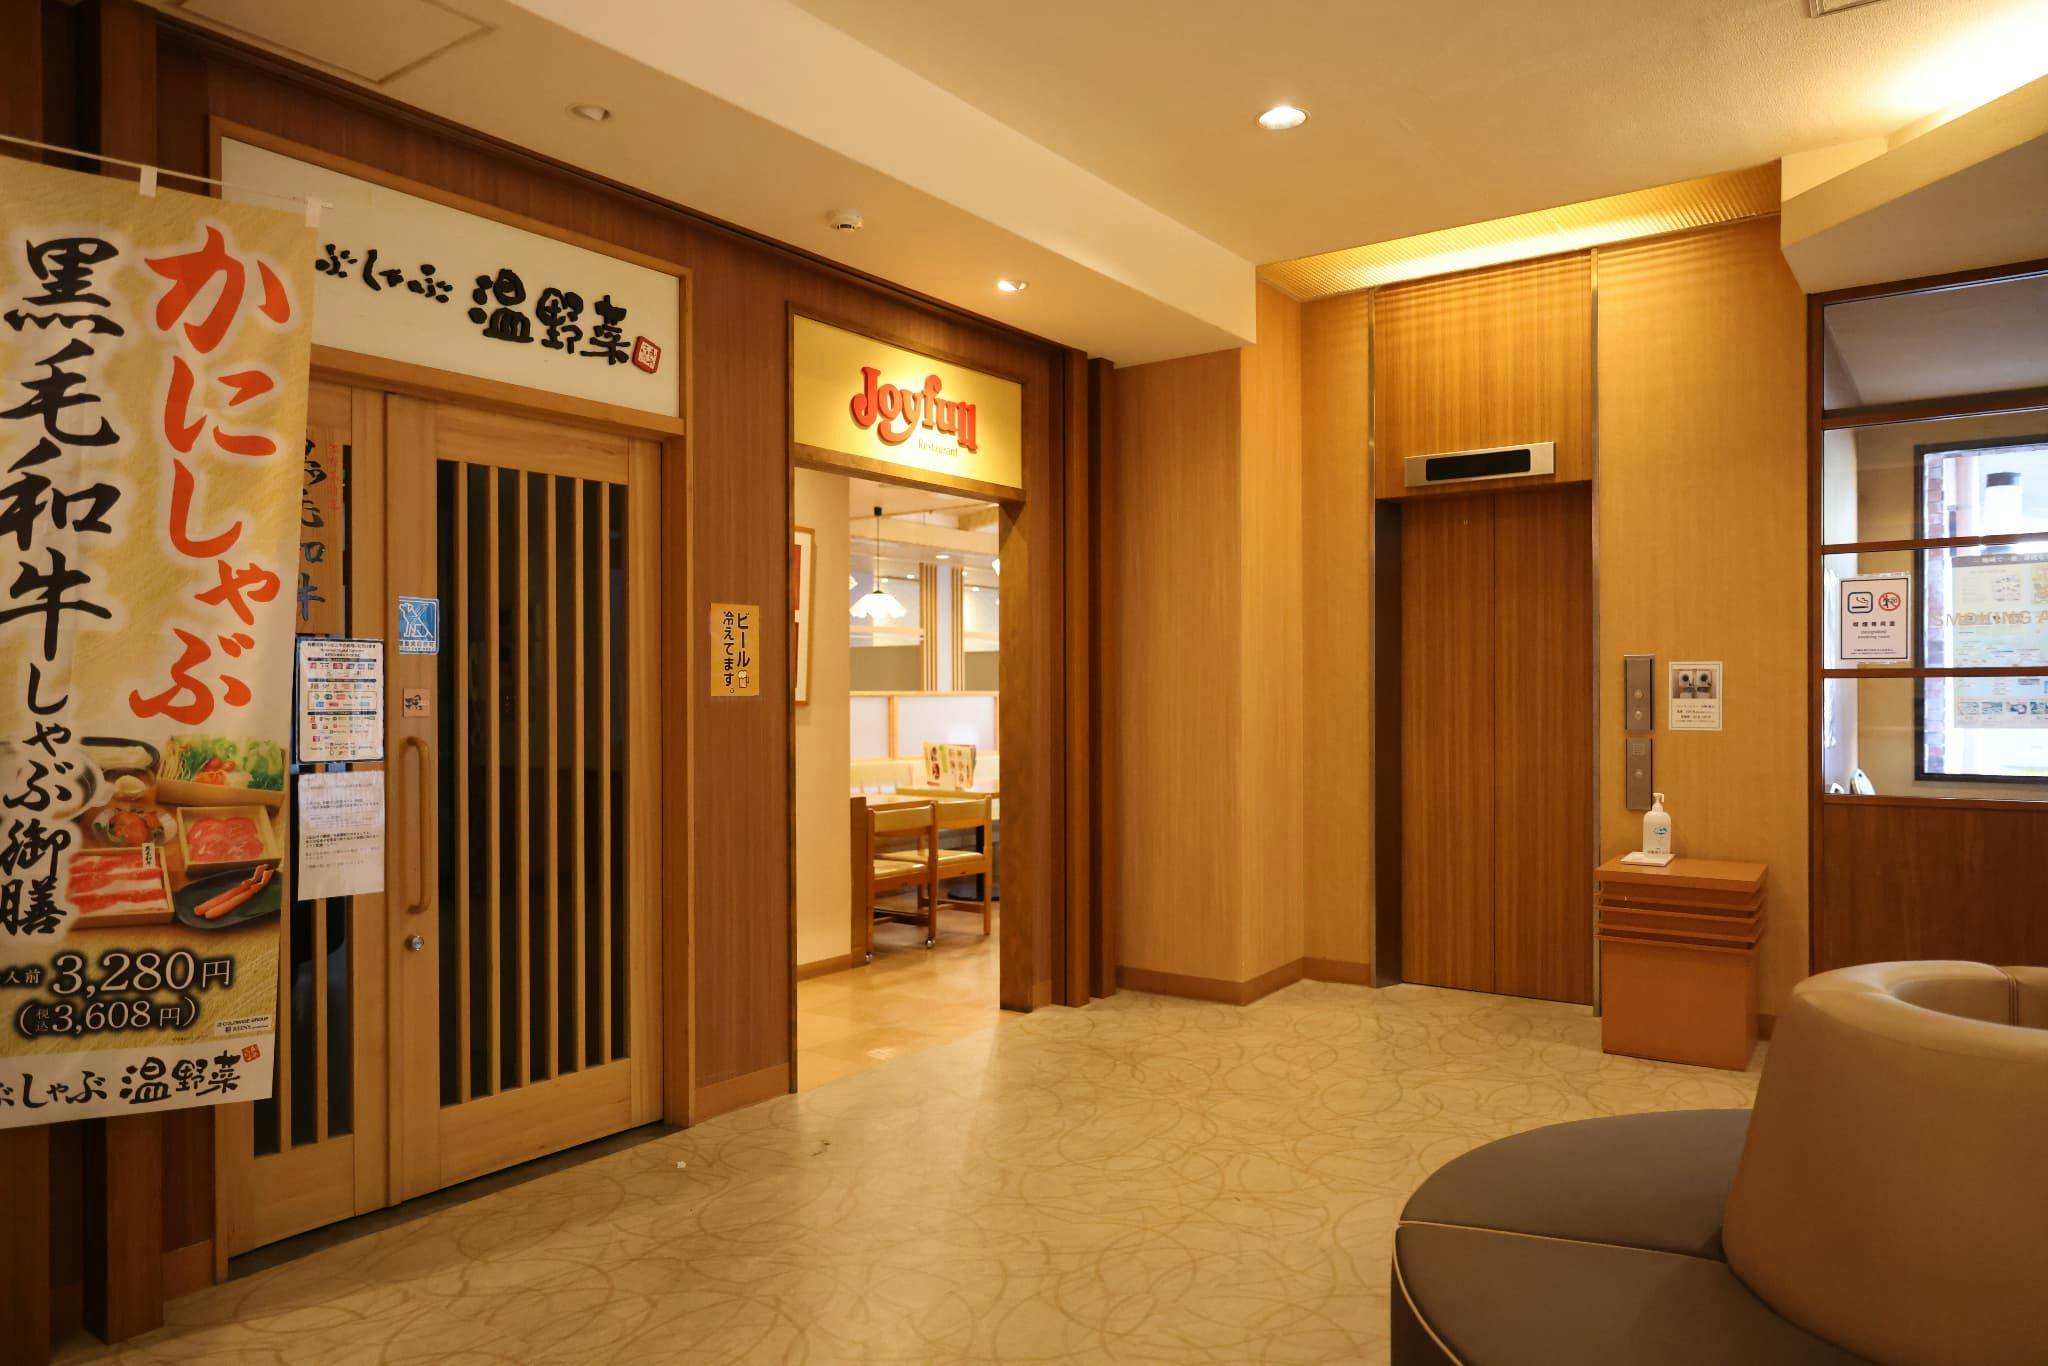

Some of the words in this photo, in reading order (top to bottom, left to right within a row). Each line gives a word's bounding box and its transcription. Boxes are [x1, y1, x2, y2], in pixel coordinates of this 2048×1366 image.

[129, 224, 291, 726] かにしゃぶ
[737, 610, 750, 667] ビール
[53, 951, 231, 999] 3,280円
